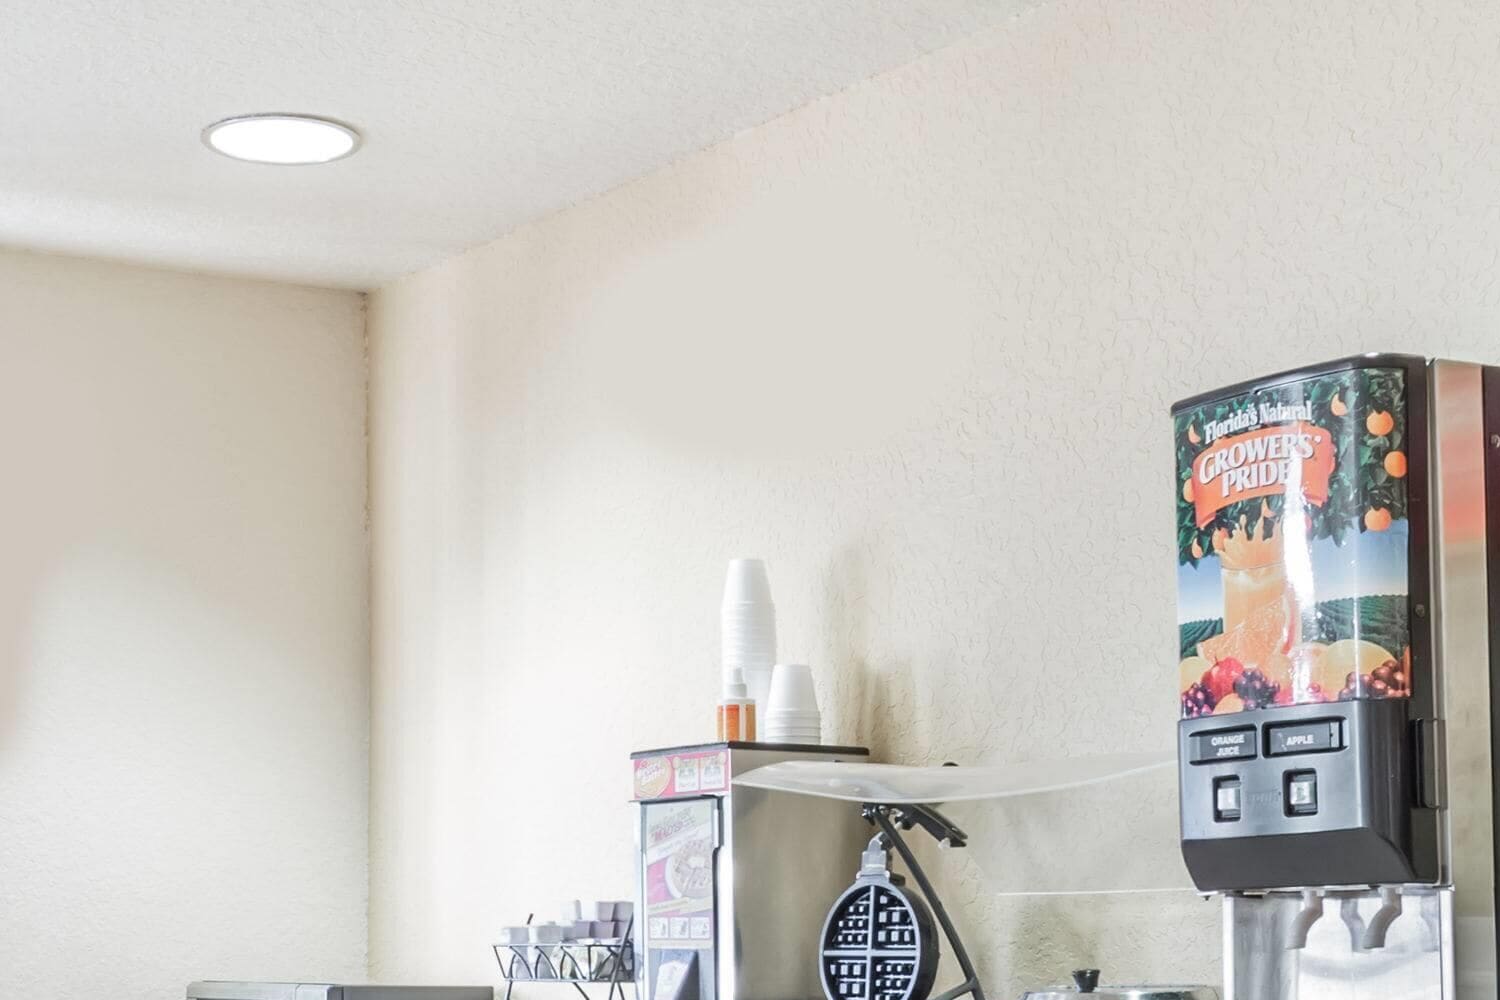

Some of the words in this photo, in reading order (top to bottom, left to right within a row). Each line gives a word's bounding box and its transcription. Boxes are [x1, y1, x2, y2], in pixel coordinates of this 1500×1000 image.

[1203, 403, 1258, 445] Florida's
[1259, 400, 1313, 424] Natural
[1222, 459, 1293, 498] PRIDE
[1211, 734, 1245, 746] ORANGE
[1286, 734, 1314, 746] APPLE
[1216, 746, 1240, 756] JUICE
